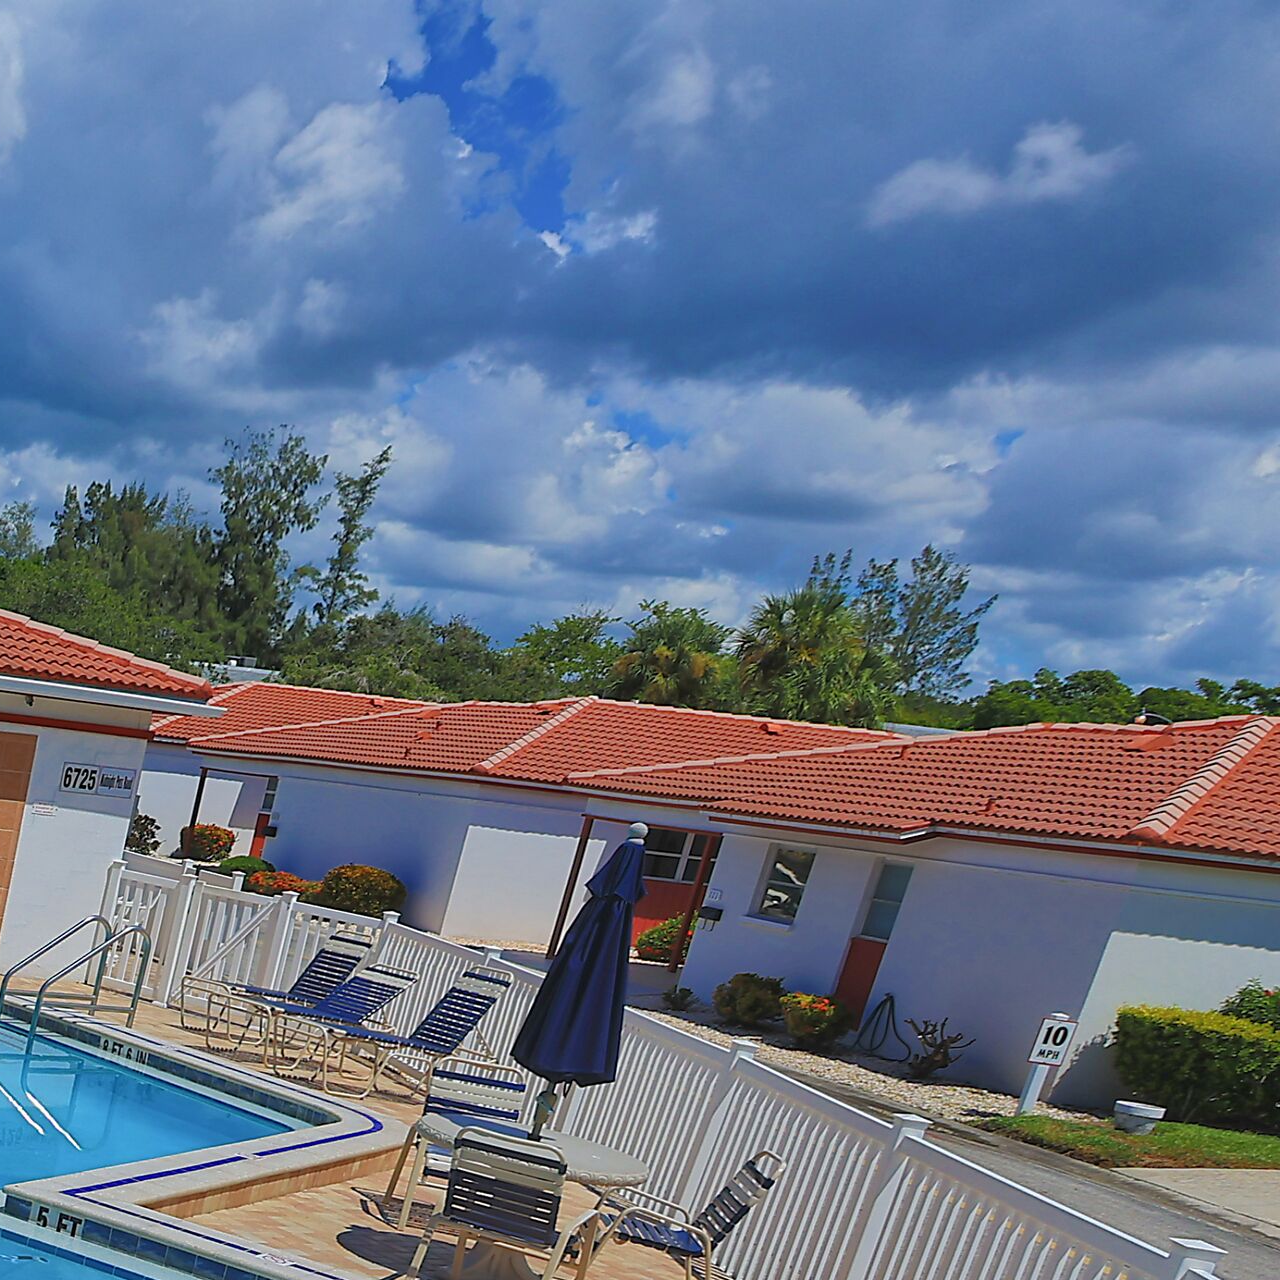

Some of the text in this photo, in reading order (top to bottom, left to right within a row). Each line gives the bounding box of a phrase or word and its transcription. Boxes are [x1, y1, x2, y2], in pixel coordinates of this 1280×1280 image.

[63, 766, 98, 791] 6725
[1042, 1025, 1069, 1047] 10
[111, 1041, 124, 1056] FT
[135, 1049, 148, 1065] IN
[1036, 1049, 1060, 1060] MPH
[36, 1205, 83, 1238] 5 FT
